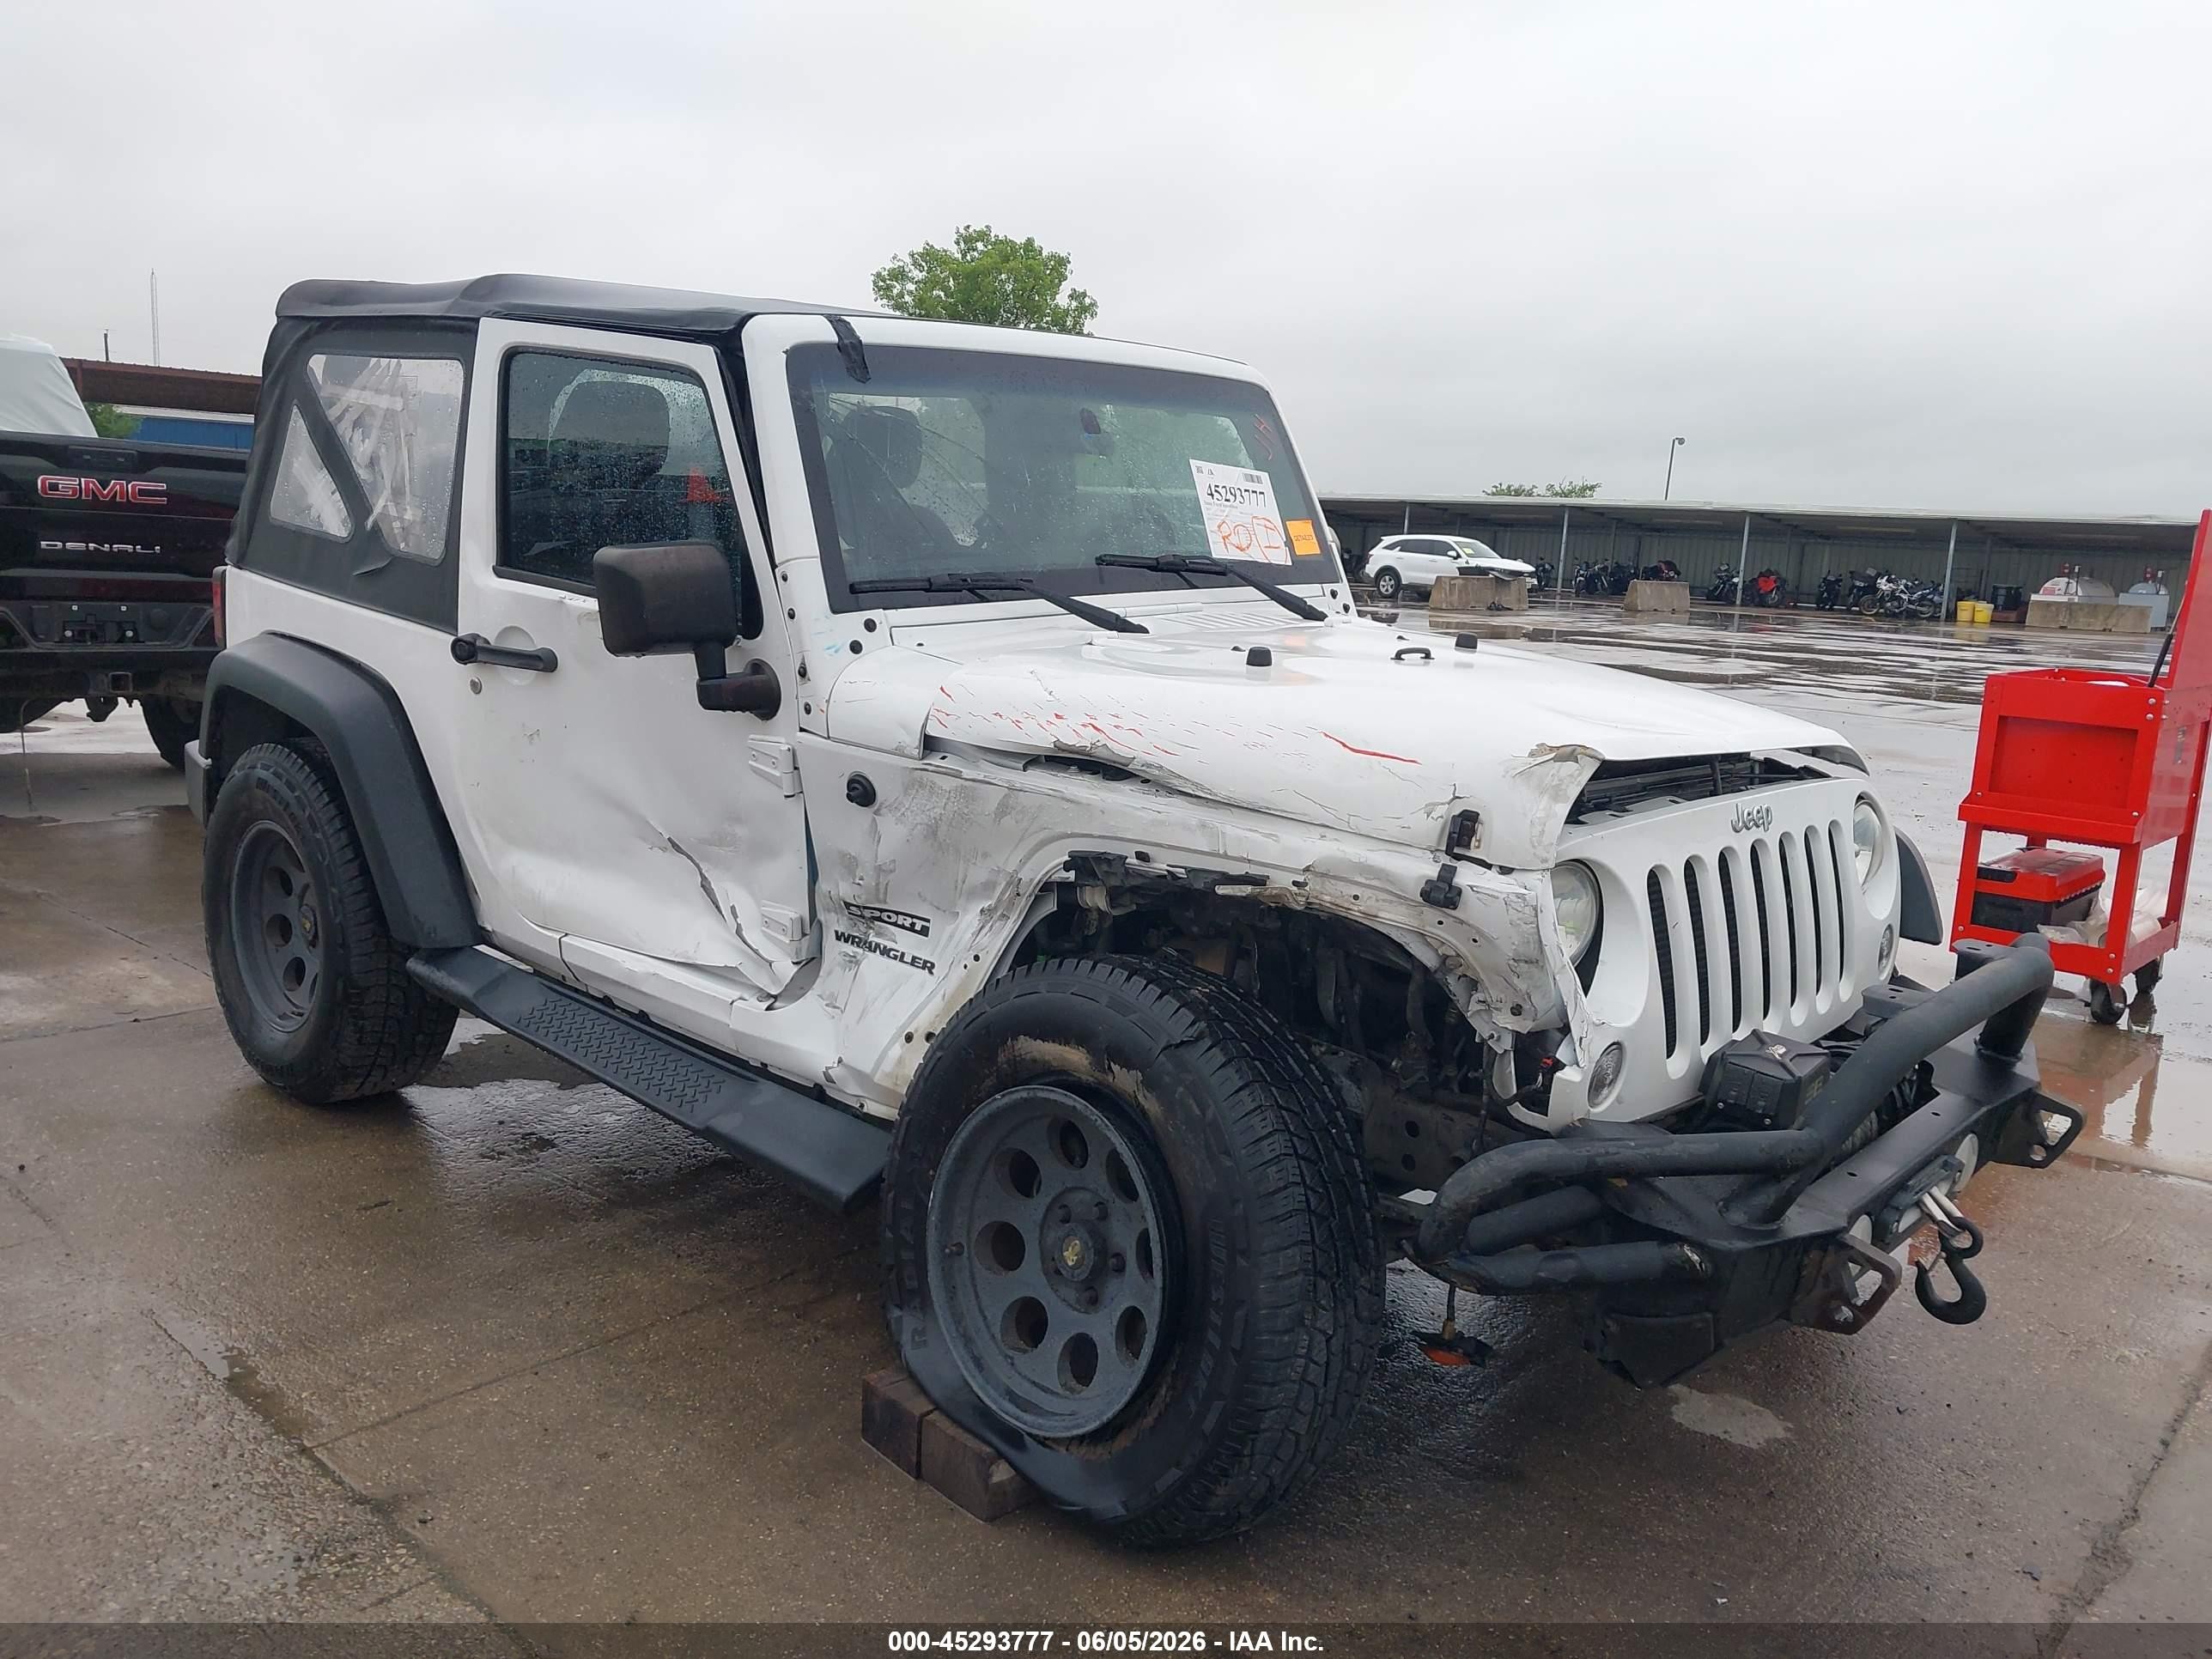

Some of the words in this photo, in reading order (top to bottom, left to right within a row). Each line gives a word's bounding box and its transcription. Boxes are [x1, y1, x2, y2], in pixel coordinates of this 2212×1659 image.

[38, 475, 167, 504] GMC
[1206, 483, 1267, 508] 45293777
[40, 541, 161, 553] DENALI
[1731, 803, 1773, 834] Jeep
[847, 905, 931, 931] SPORT
[834, 929, 935, 975] WRANGLER
